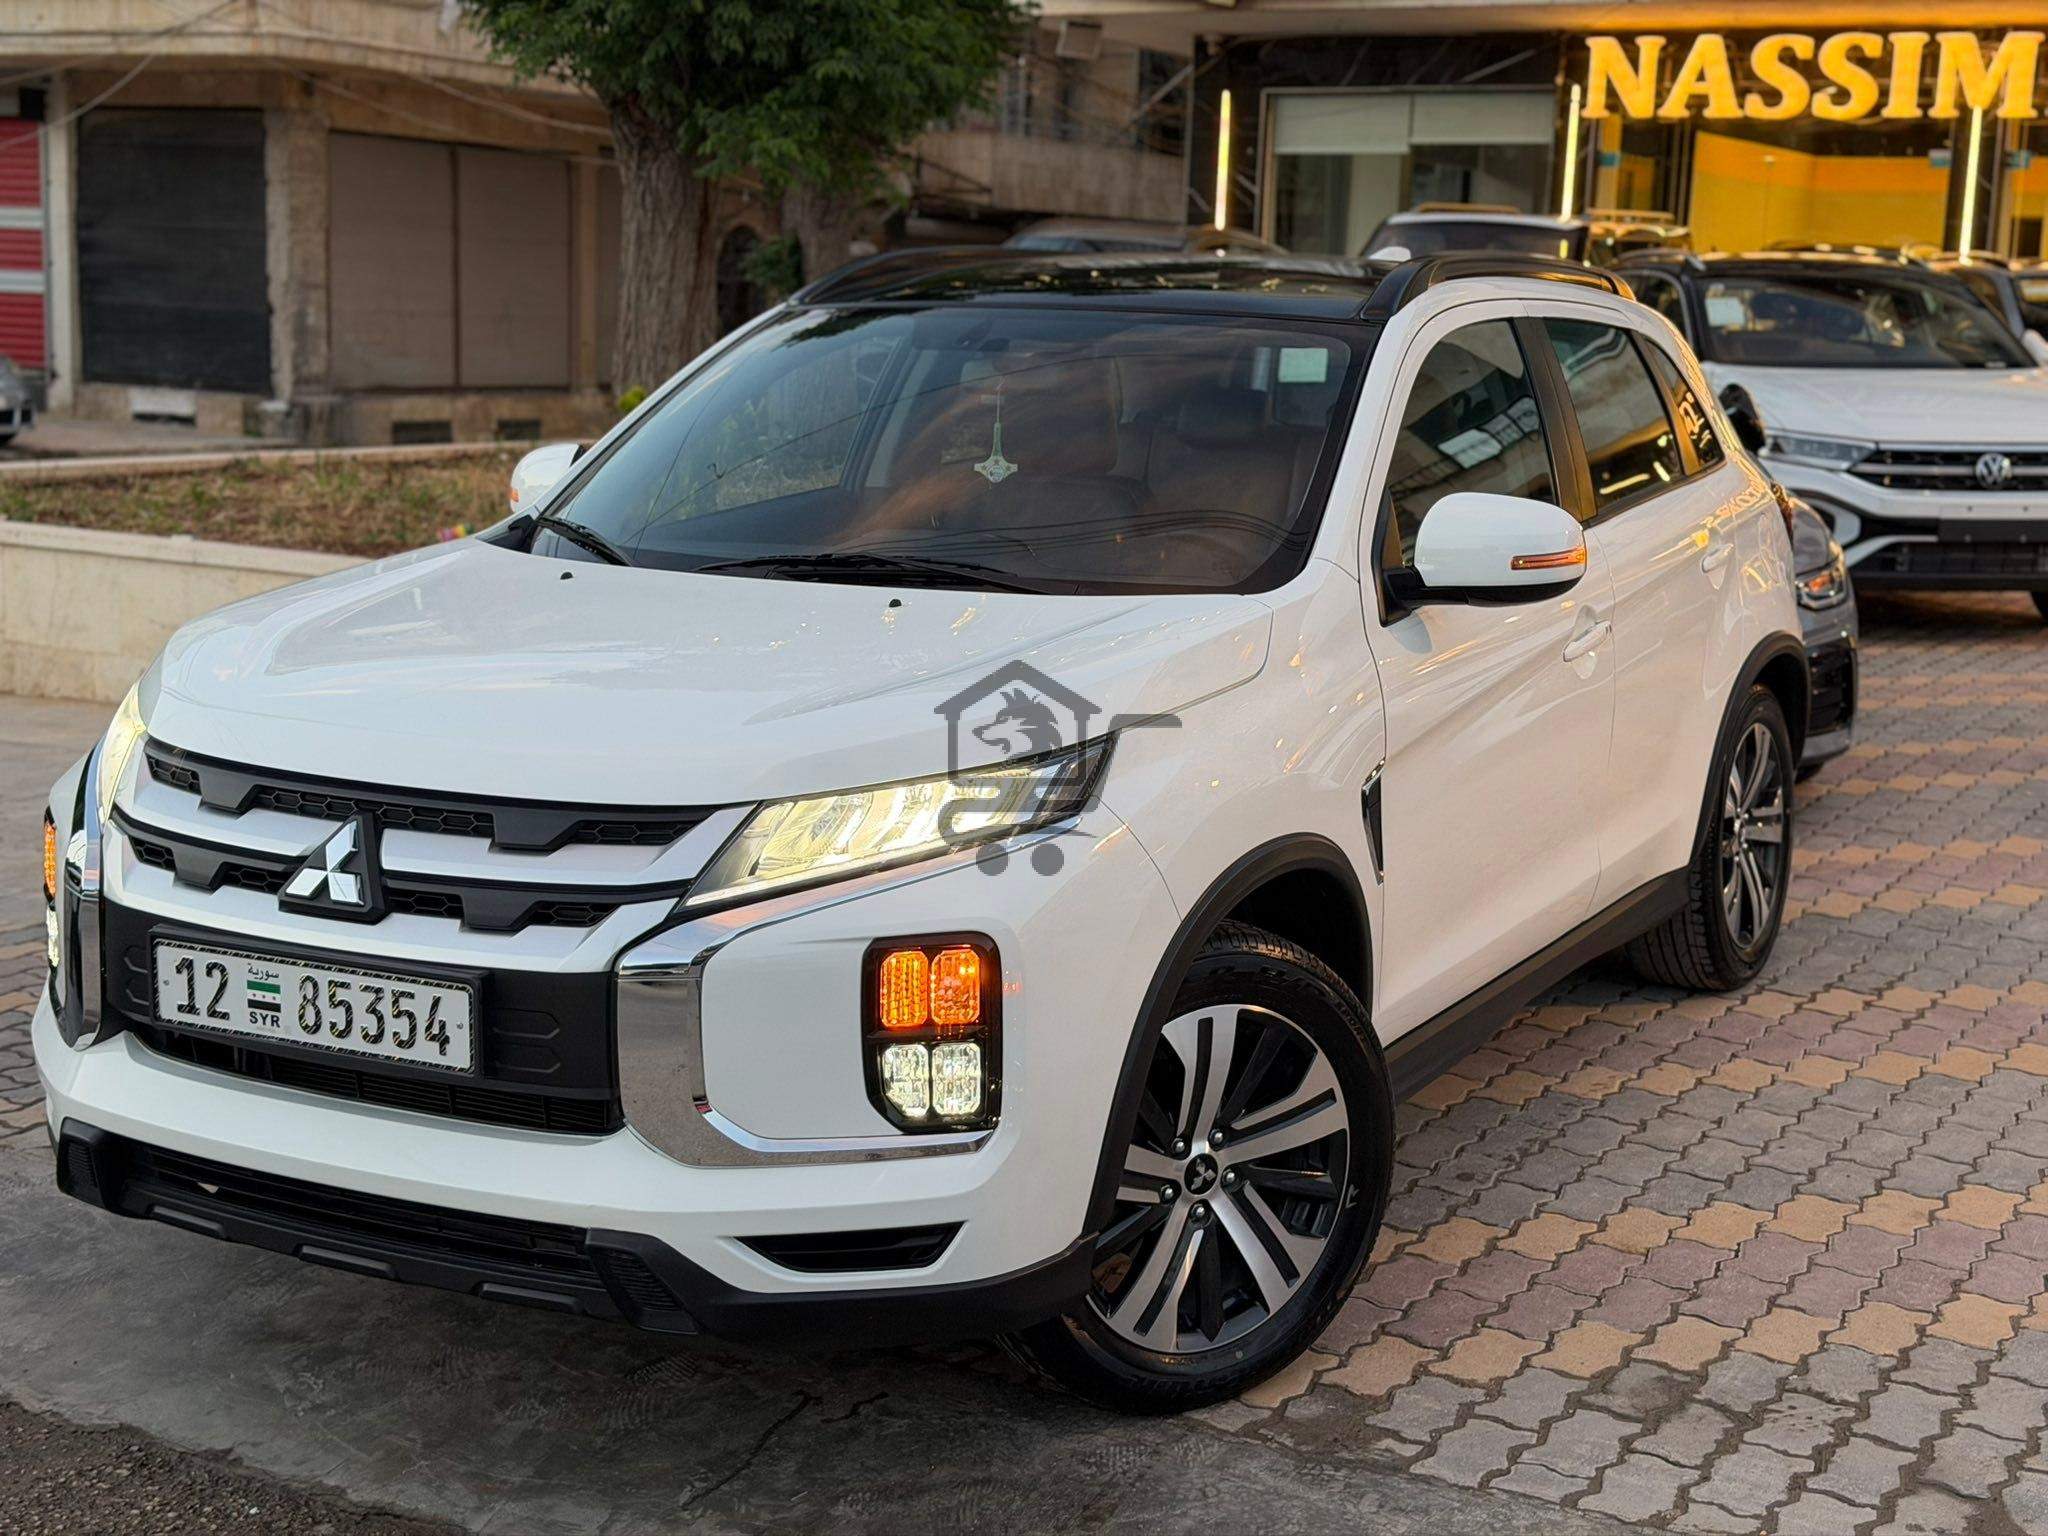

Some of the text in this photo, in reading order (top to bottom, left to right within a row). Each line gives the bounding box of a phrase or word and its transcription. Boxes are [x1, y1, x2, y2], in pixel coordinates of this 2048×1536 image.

[1581, 32, 2045, 119] NASSIM
[247, 963, 280, 981] سورية
[175, 957, 451, 1056] 12 85354
[249, 1011, 281, 1028] SYR
